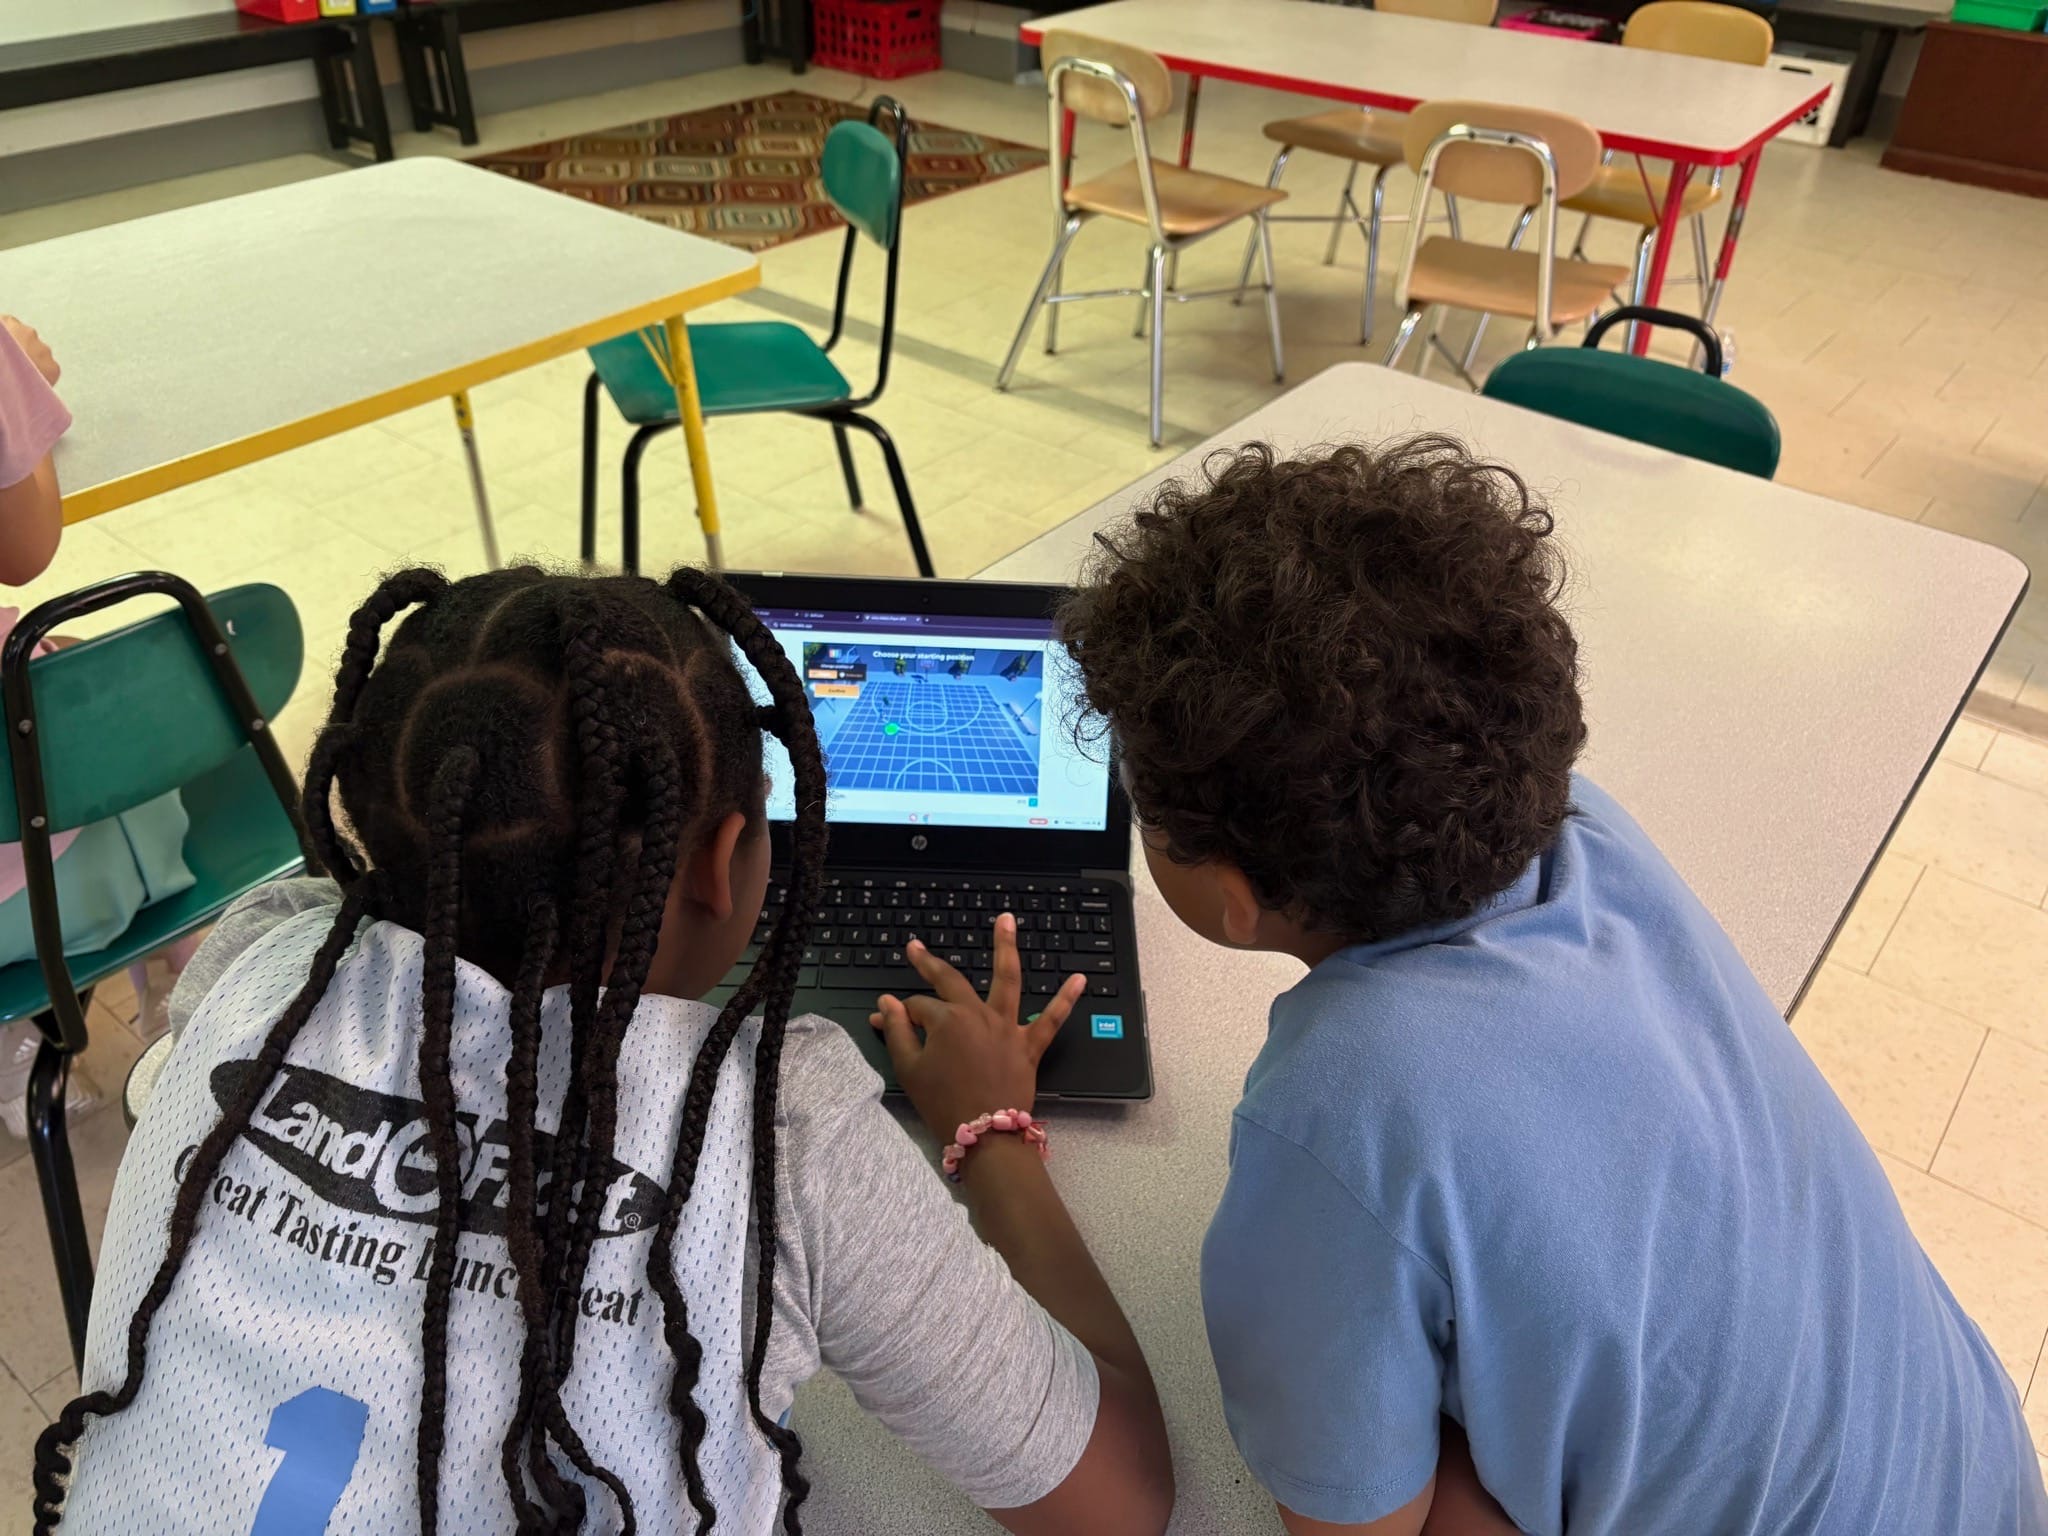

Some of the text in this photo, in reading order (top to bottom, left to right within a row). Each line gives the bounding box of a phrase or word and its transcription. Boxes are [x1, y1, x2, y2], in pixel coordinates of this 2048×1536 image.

[872, 651, 899, 659] Choose
[917, 653, 945, 661] starting
[946, 654, 975, 662] position
[904, 913, 911, 922] y
[822, 930, 831, 939] d
[271, 1191, 407, 1286] Tasting
[580, 1285, 645, 1327] eat
